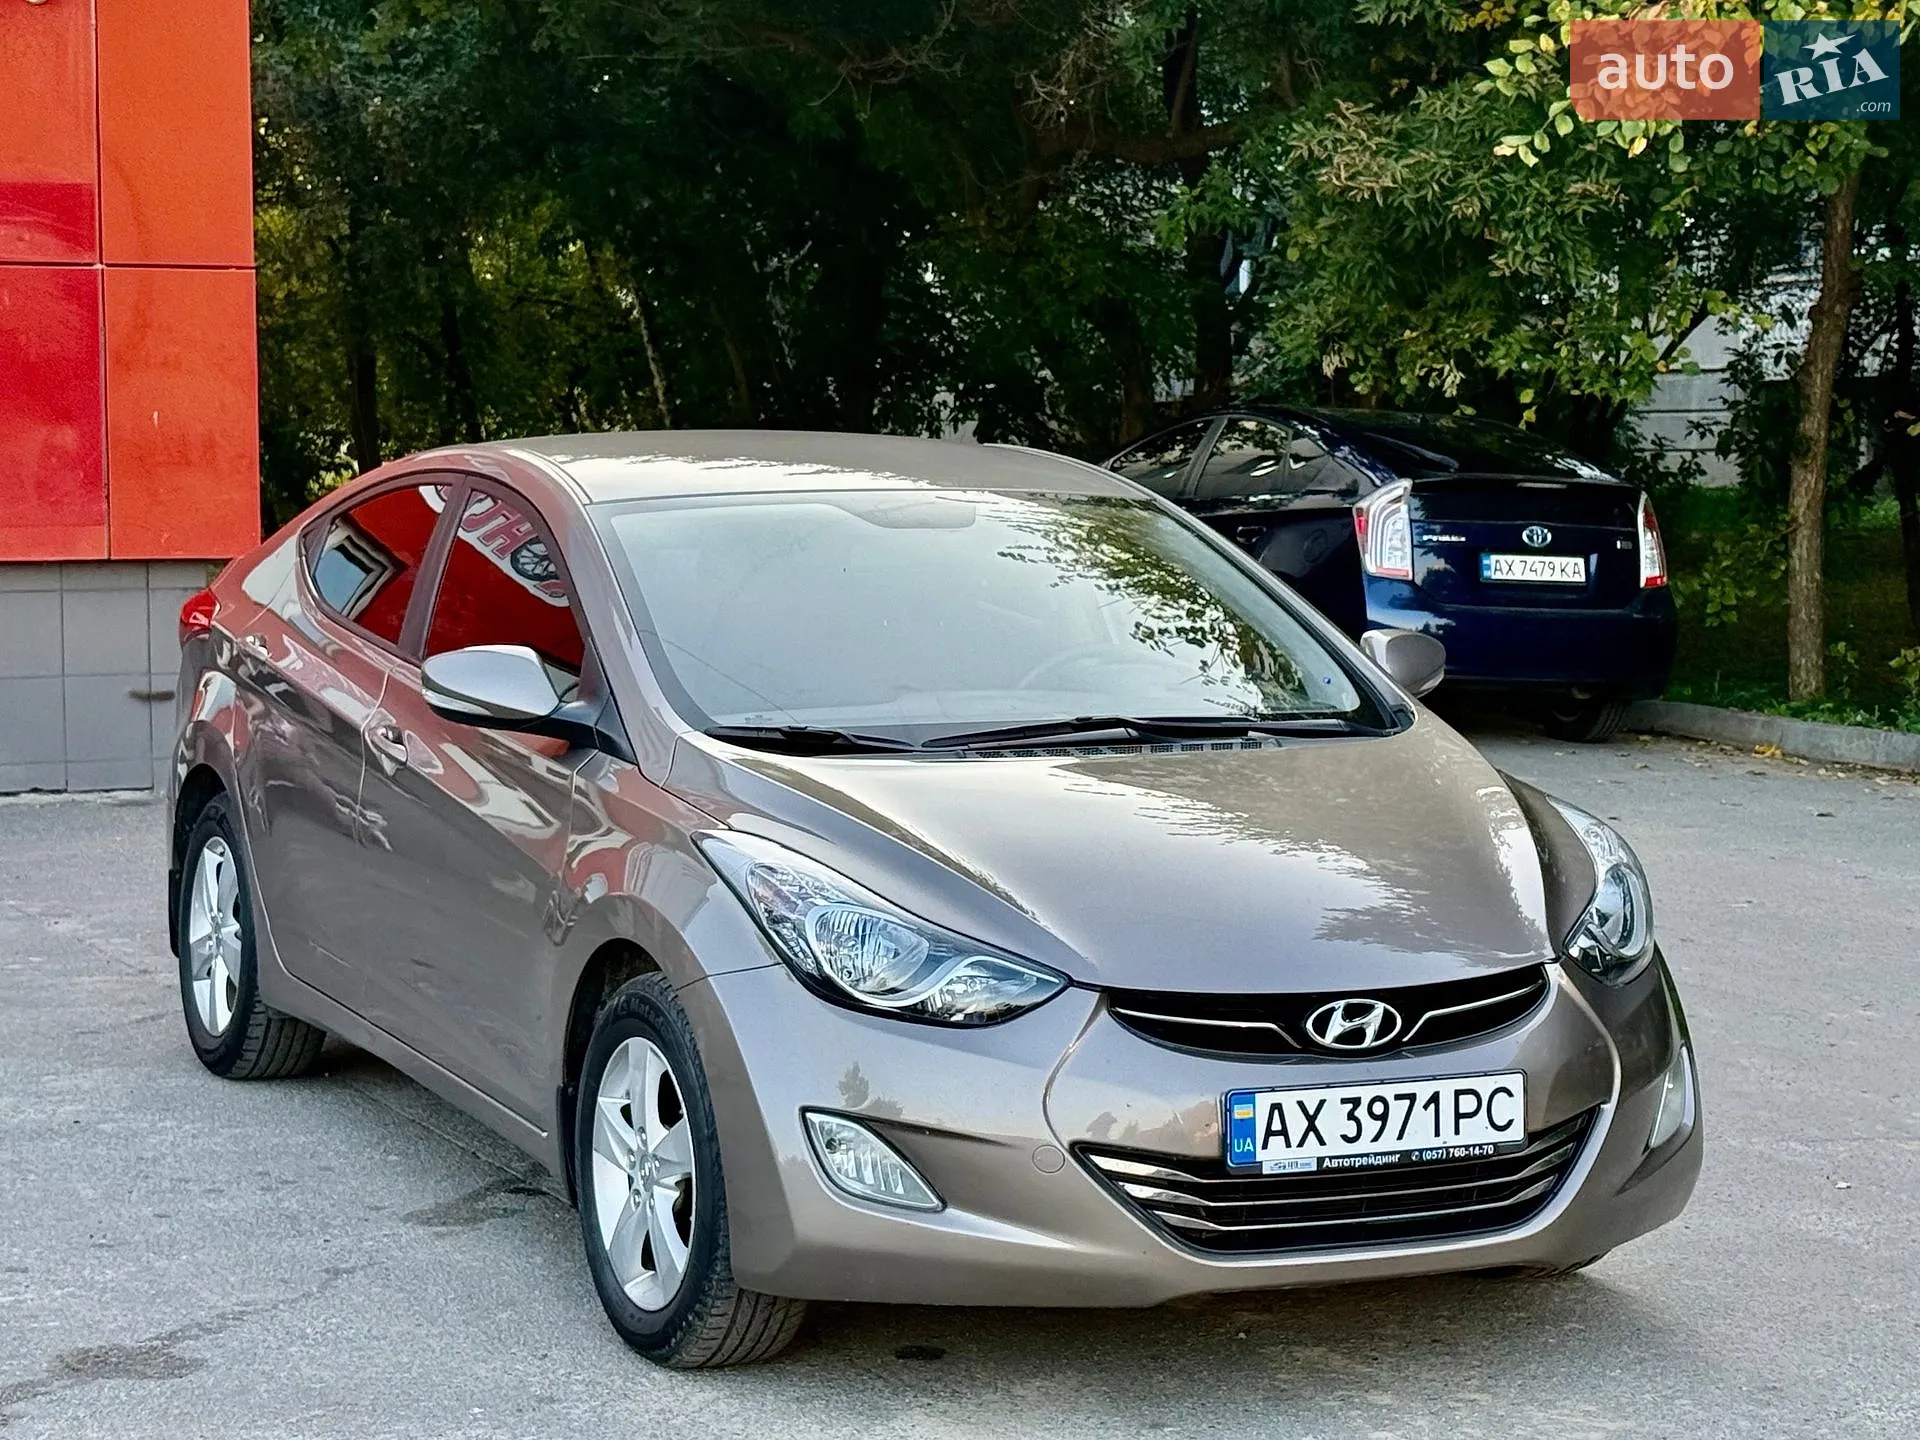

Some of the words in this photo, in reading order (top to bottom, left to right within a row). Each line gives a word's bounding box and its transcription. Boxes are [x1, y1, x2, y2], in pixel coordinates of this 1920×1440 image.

[1494, 560, 1515, 576] AX
[1520, 560, 1556, 577] 7479
[1560, 562, 1582, 578] KA
[1261, 1099, 1327, 1150] AX
[1340, 1091, 1440, 1144] 3971
[1234, 1137, 1254, 1152] UA
[1323, 1152, 1400, 1168] Автотрейдинг
[1422, 1149, 1446, 1161] (057)
[1449, 1144, 1494, 1158] 760-14-70
